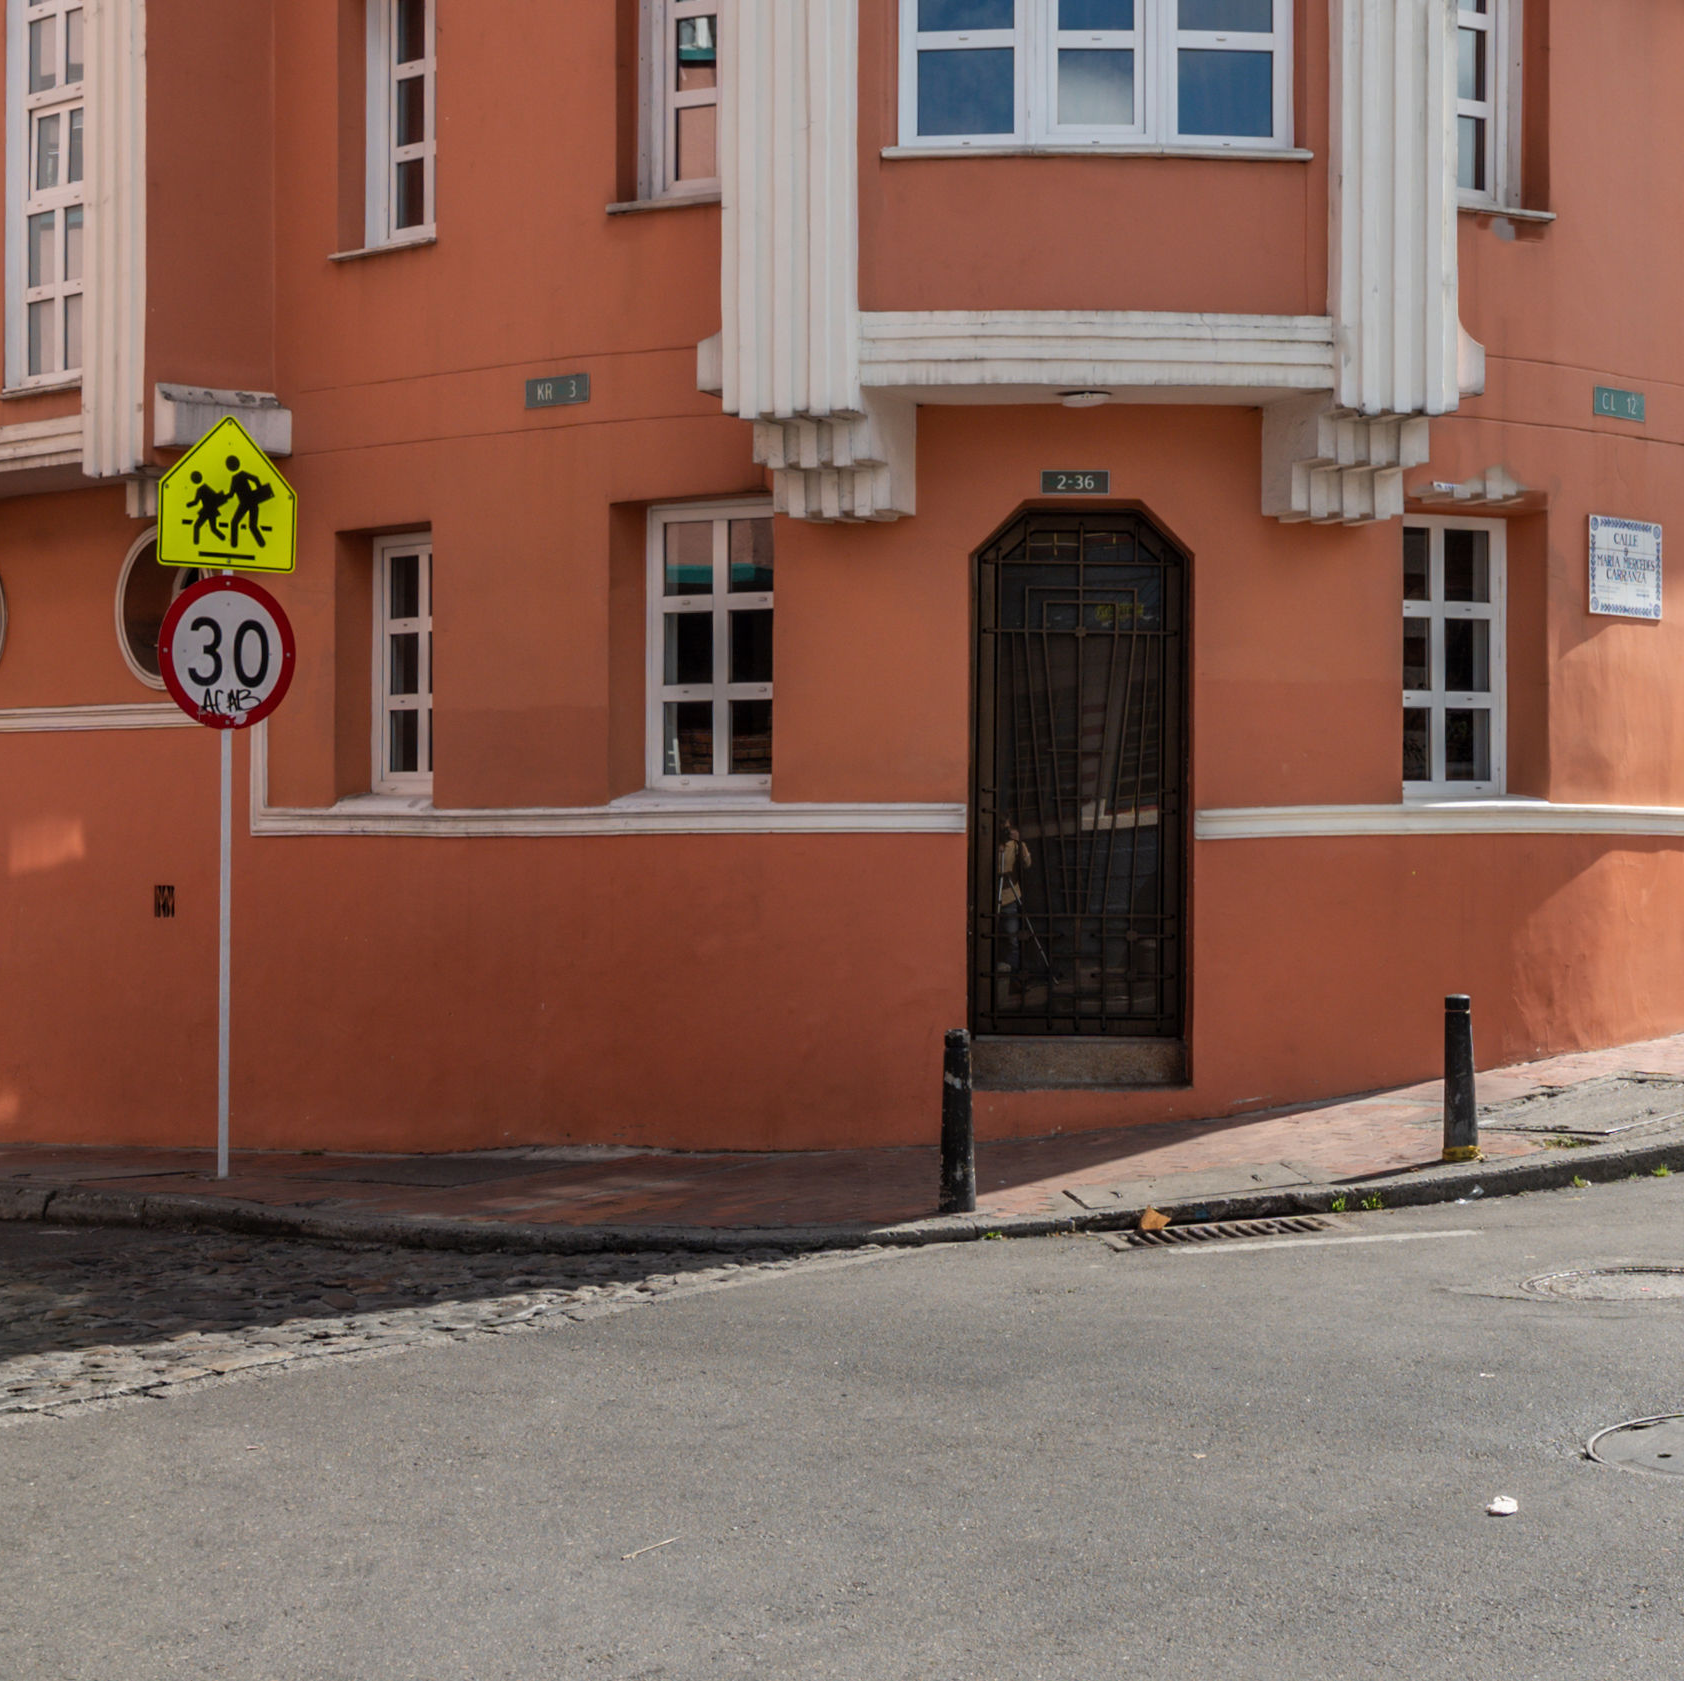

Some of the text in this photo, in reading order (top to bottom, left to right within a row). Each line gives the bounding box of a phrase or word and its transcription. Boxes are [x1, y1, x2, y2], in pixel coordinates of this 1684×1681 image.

[537, 380, 577, 401] KR 3
[1602, 392, 1637, 415] CL 12
[1056, 474, 1095, 490] 2-36
[1613, 532, 1639, 547] CALLE
[1623, 556, 1656, 572] MERCEDES
[1606, 567, 1647, 584] CARRANZA
[188, 616, 269, 688] 30
[201, 688, 261, 714] ACAB
